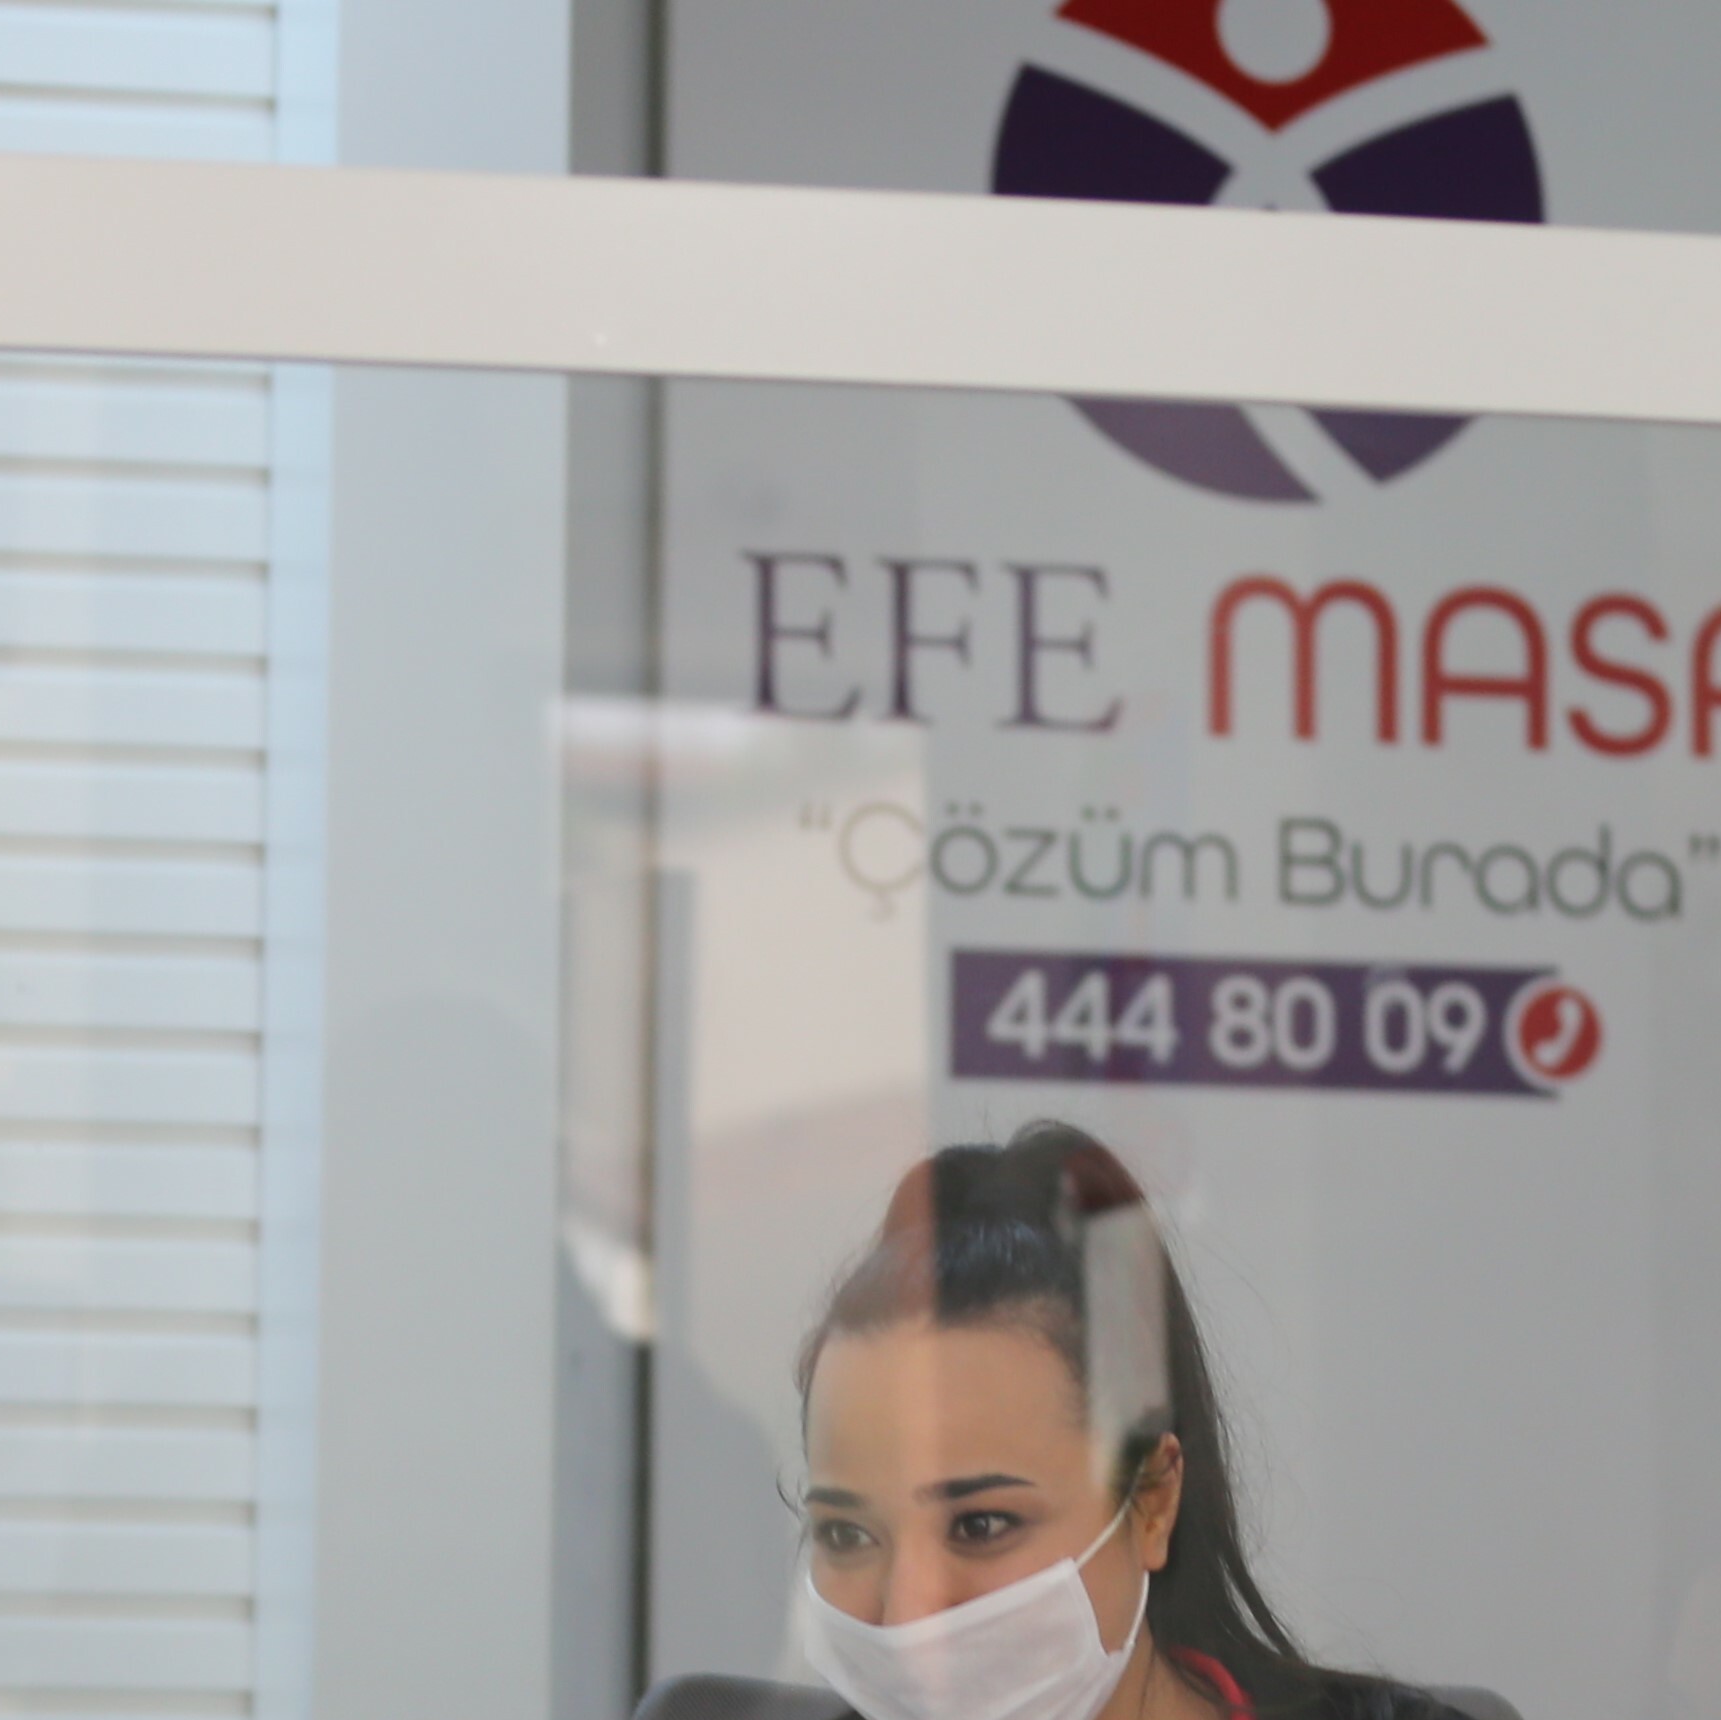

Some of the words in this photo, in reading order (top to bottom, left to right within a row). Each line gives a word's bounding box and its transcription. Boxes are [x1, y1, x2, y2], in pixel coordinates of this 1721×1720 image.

[743, 551, 1124, 735] EFE
[987, 971, 1179, 1062] 444
[1210, 975, 1335, 1069] 80
[1363, 980, 1484, 1075] 09
